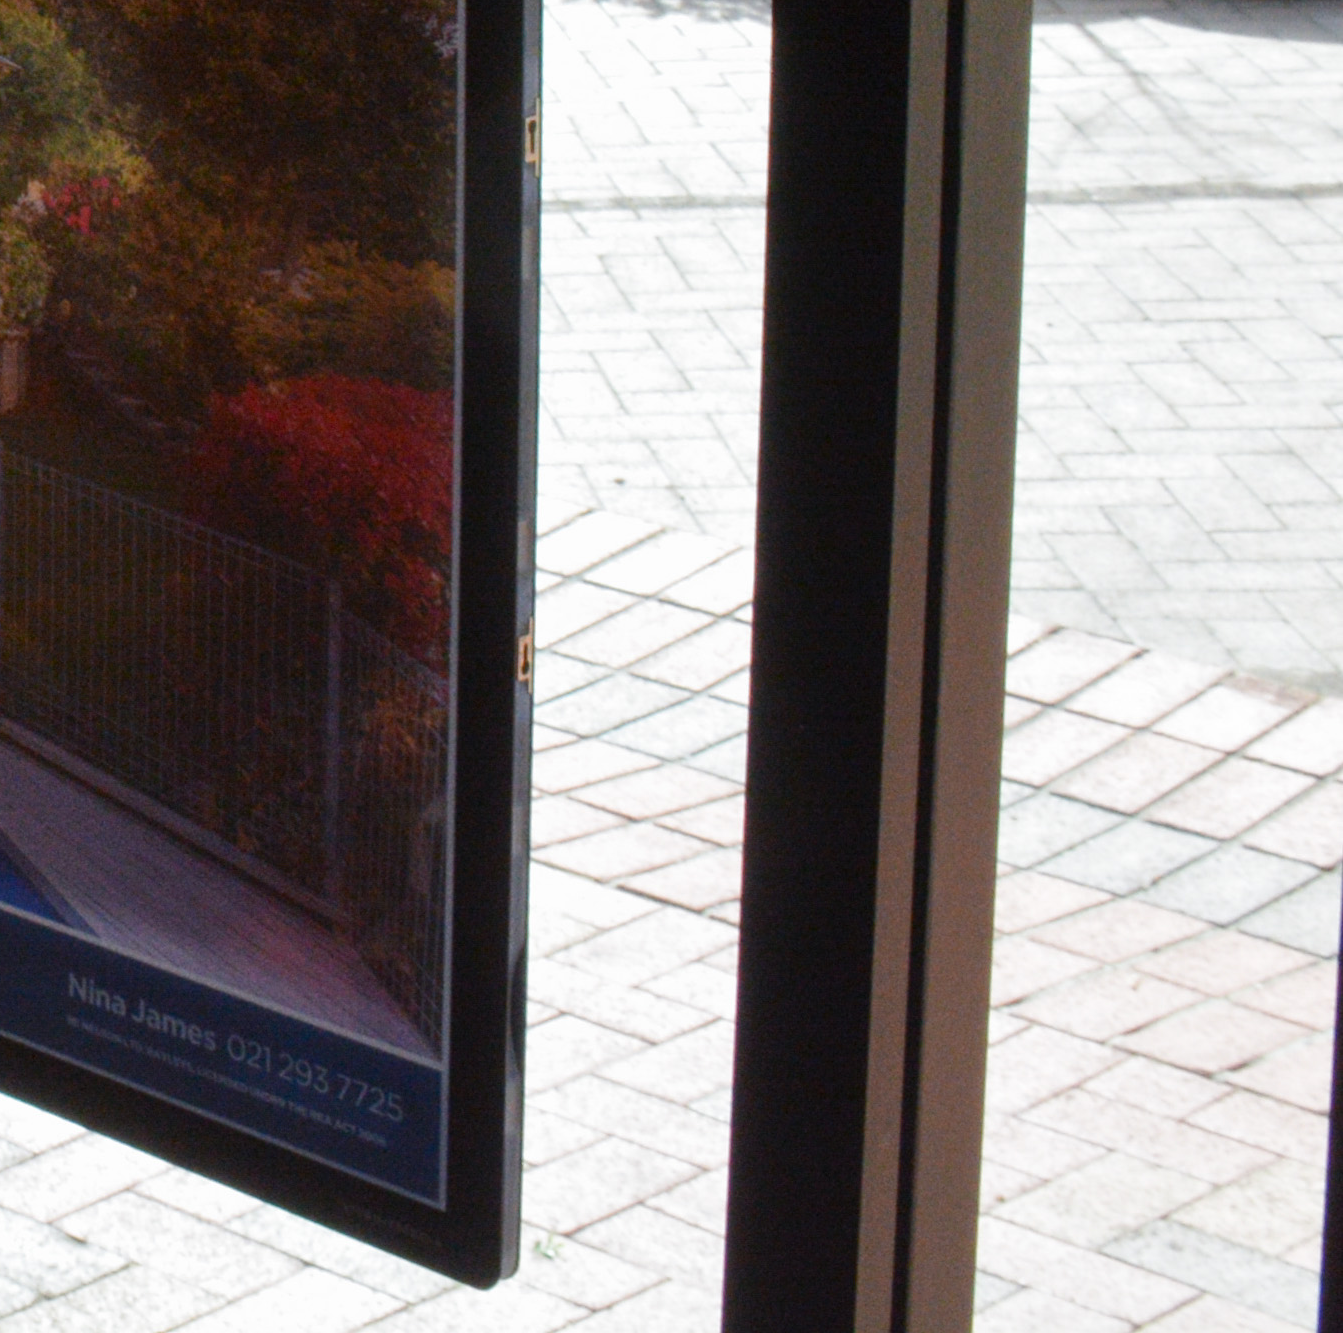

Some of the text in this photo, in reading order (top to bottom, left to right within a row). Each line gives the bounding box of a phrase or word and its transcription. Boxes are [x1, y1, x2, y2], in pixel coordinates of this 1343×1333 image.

[68, 972, 127, 1015] Nina
[131, 997, 218, 1052] James
[227, 1034, 272, 1073] 021
[279, 1054, 329, 1094] 293
[337, 1074, 404, 1123] 7725
